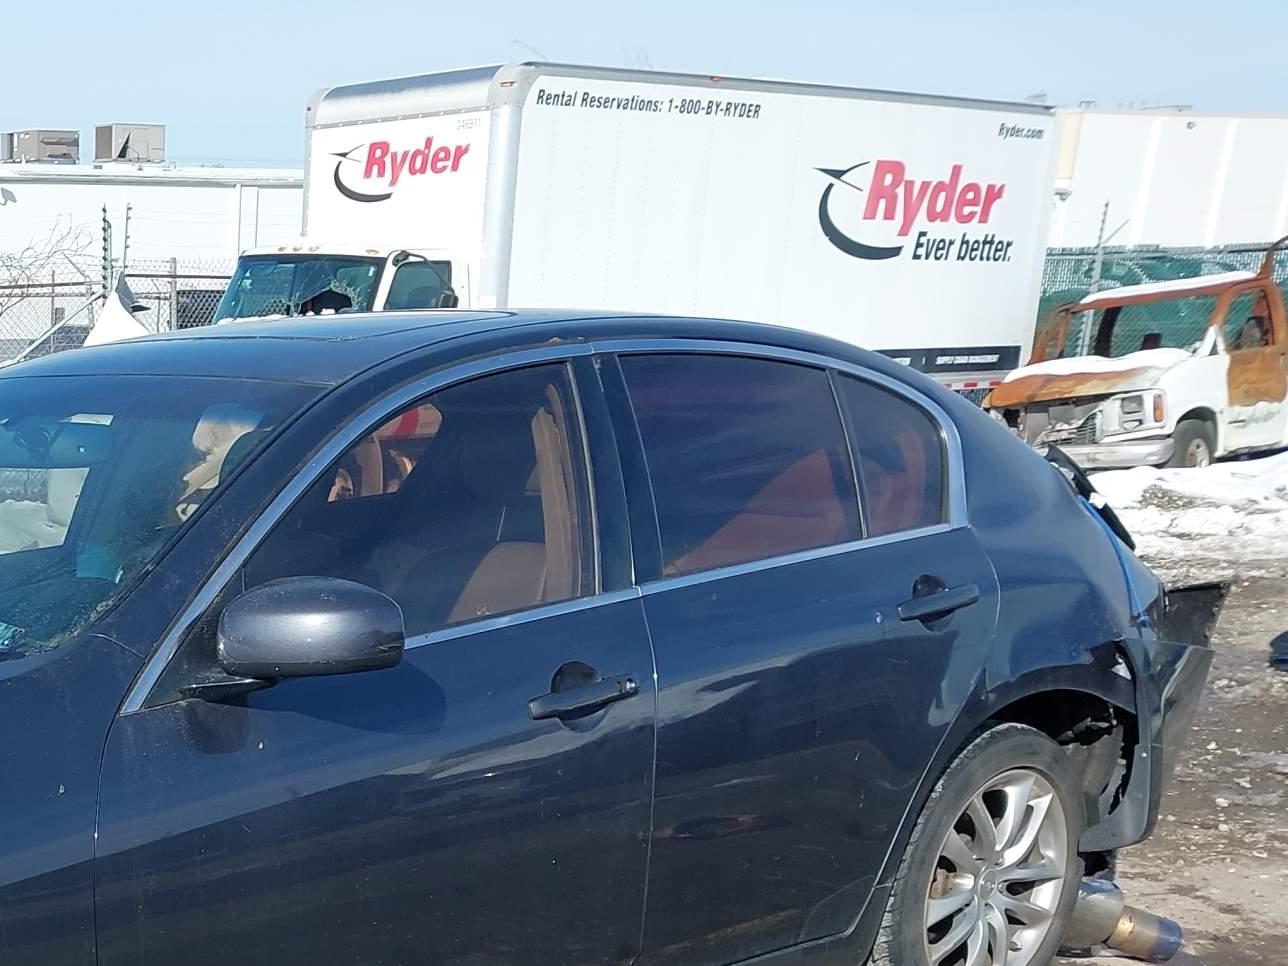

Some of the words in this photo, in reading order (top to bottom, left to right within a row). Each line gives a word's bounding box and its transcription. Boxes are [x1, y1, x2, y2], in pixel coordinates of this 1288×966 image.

[535, 88, 578, 107] Rental
[580, 91, 664, 113] Reservations:
[667, 97, 762, 120] 1-800-BY-RYDER
[998, 122, 1045, 140] Ryder.com
[363, 137, 471, 187] Ryder
[862, 159, 1006, 237] Ryder
[912, 231, 955, 261] Ever
[956, 232, 1014, 262] better.
